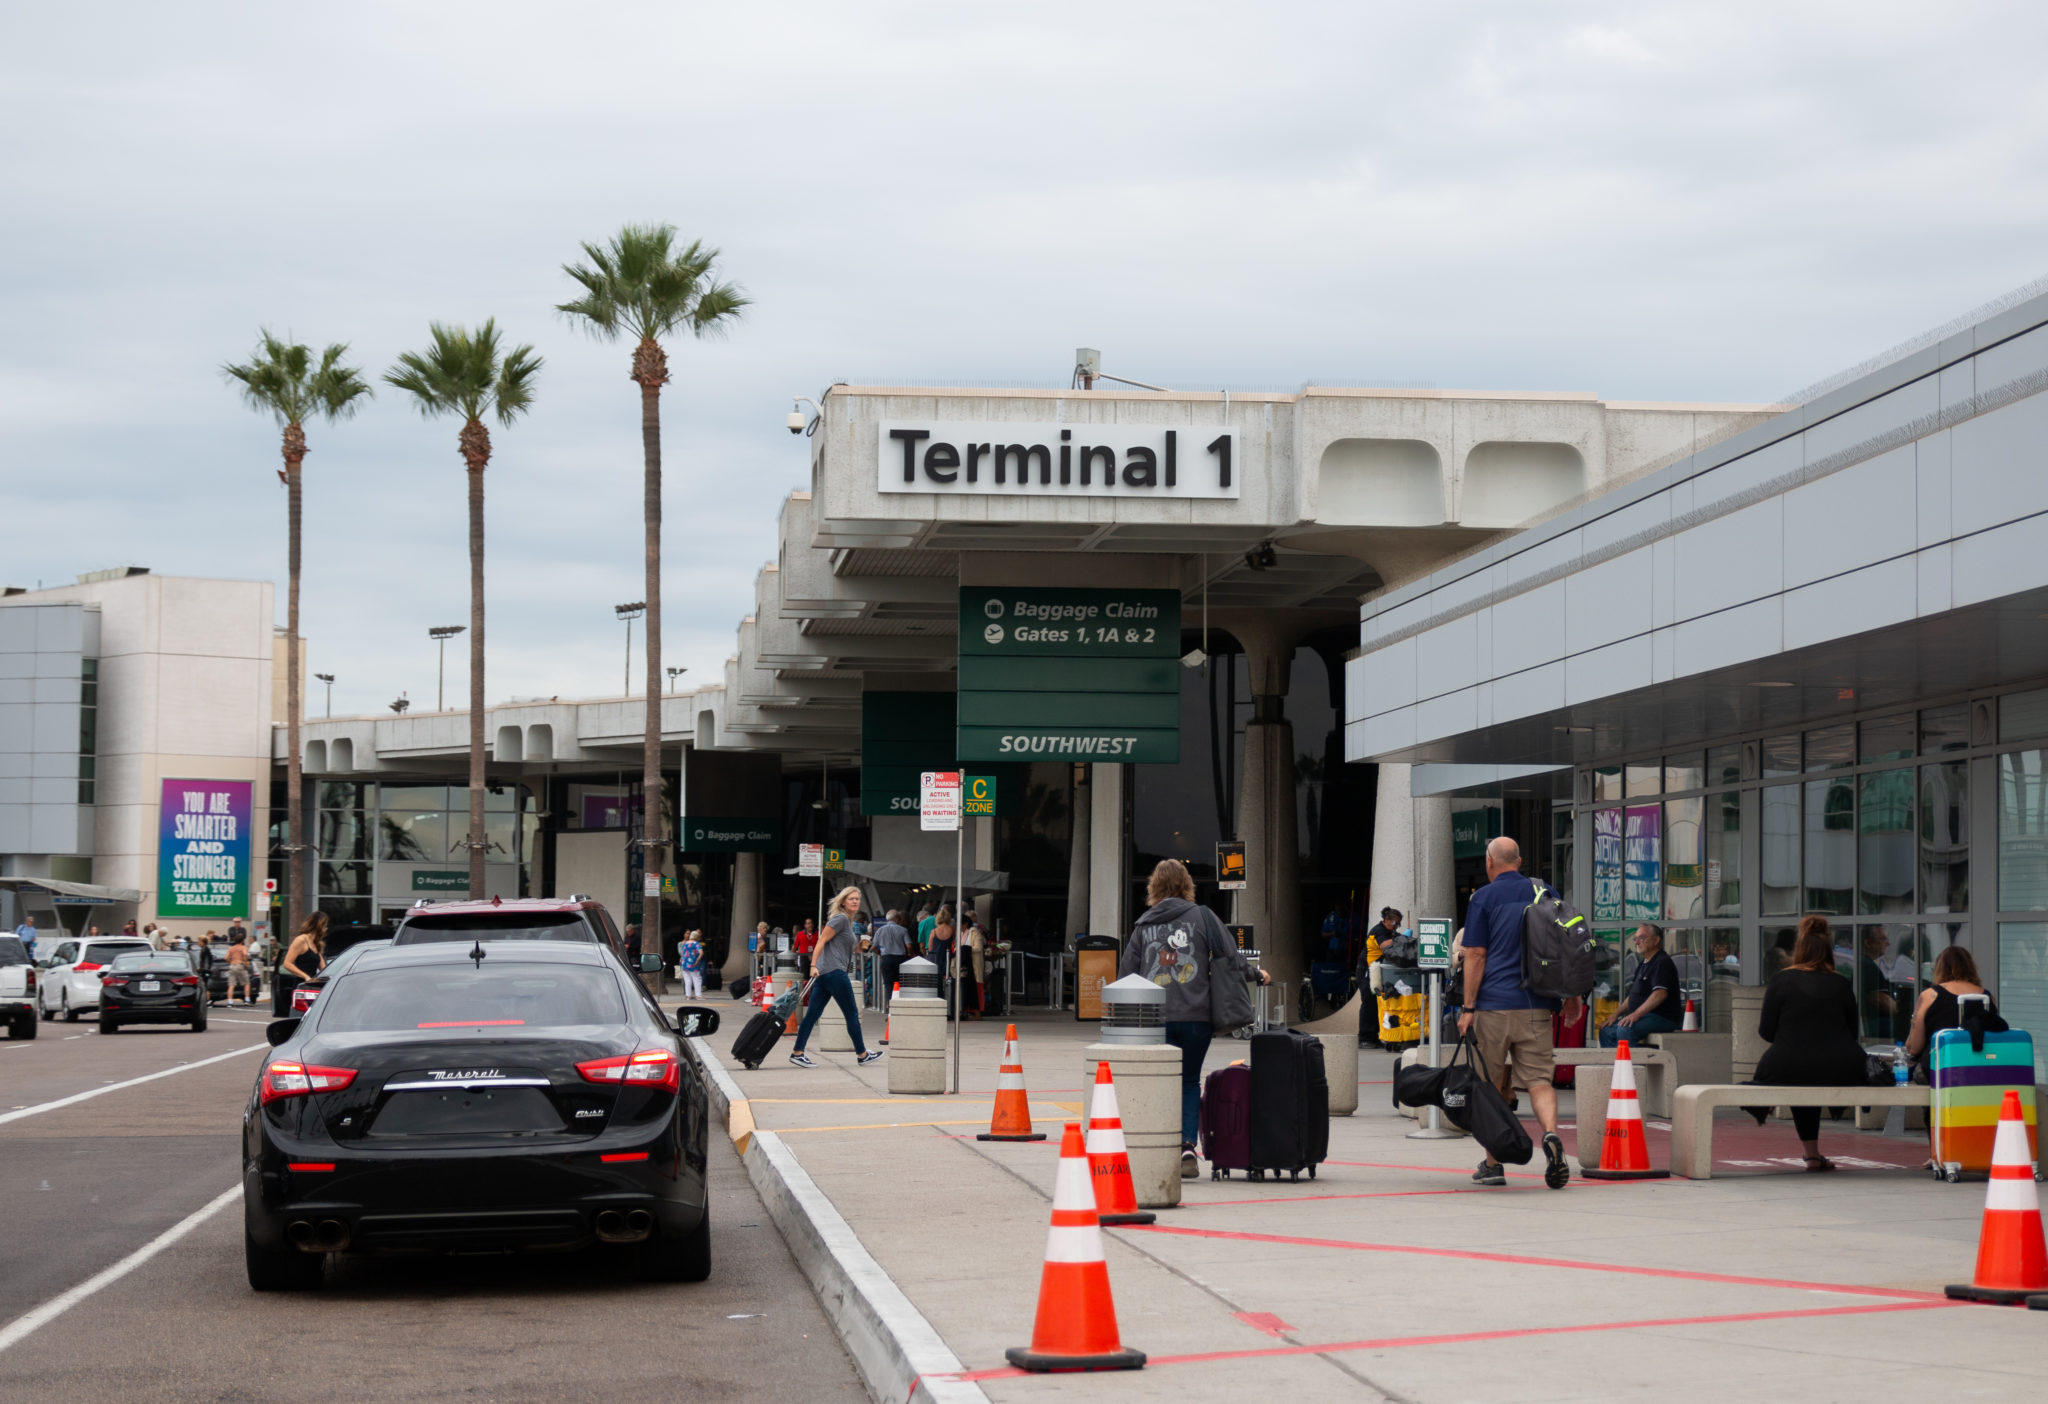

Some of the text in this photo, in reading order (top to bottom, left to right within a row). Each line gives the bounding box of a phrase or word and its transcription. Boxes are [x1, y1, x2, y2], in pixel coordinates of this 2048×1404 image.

[889, 429, 1232, 488] Terminal 1
[1013, 601, 1158, 621] Baggage Claim
[1014, 626, 1156, 644] Gates 1, 1A & 2
[999, 735, 1138, 755] SOUTHWEST
[972, 778, 988, 799] C
[183, 791, 231, 815] YOU ARE
[965, 802, 993, 813] ZONE
[174, 813, 237, 841] SMARTER
[707, 830, 772, 841] Baggage Claim
[185, 840, 225, 854] AND
[830, 850, 840, 862] D
[172, 854, 236, 880] STRONGER
[172, 881, 237, 894] THAN YOU
[175, 893, 232, 906] REALIZE
[427, 1069, 506, 1080] Maserati
